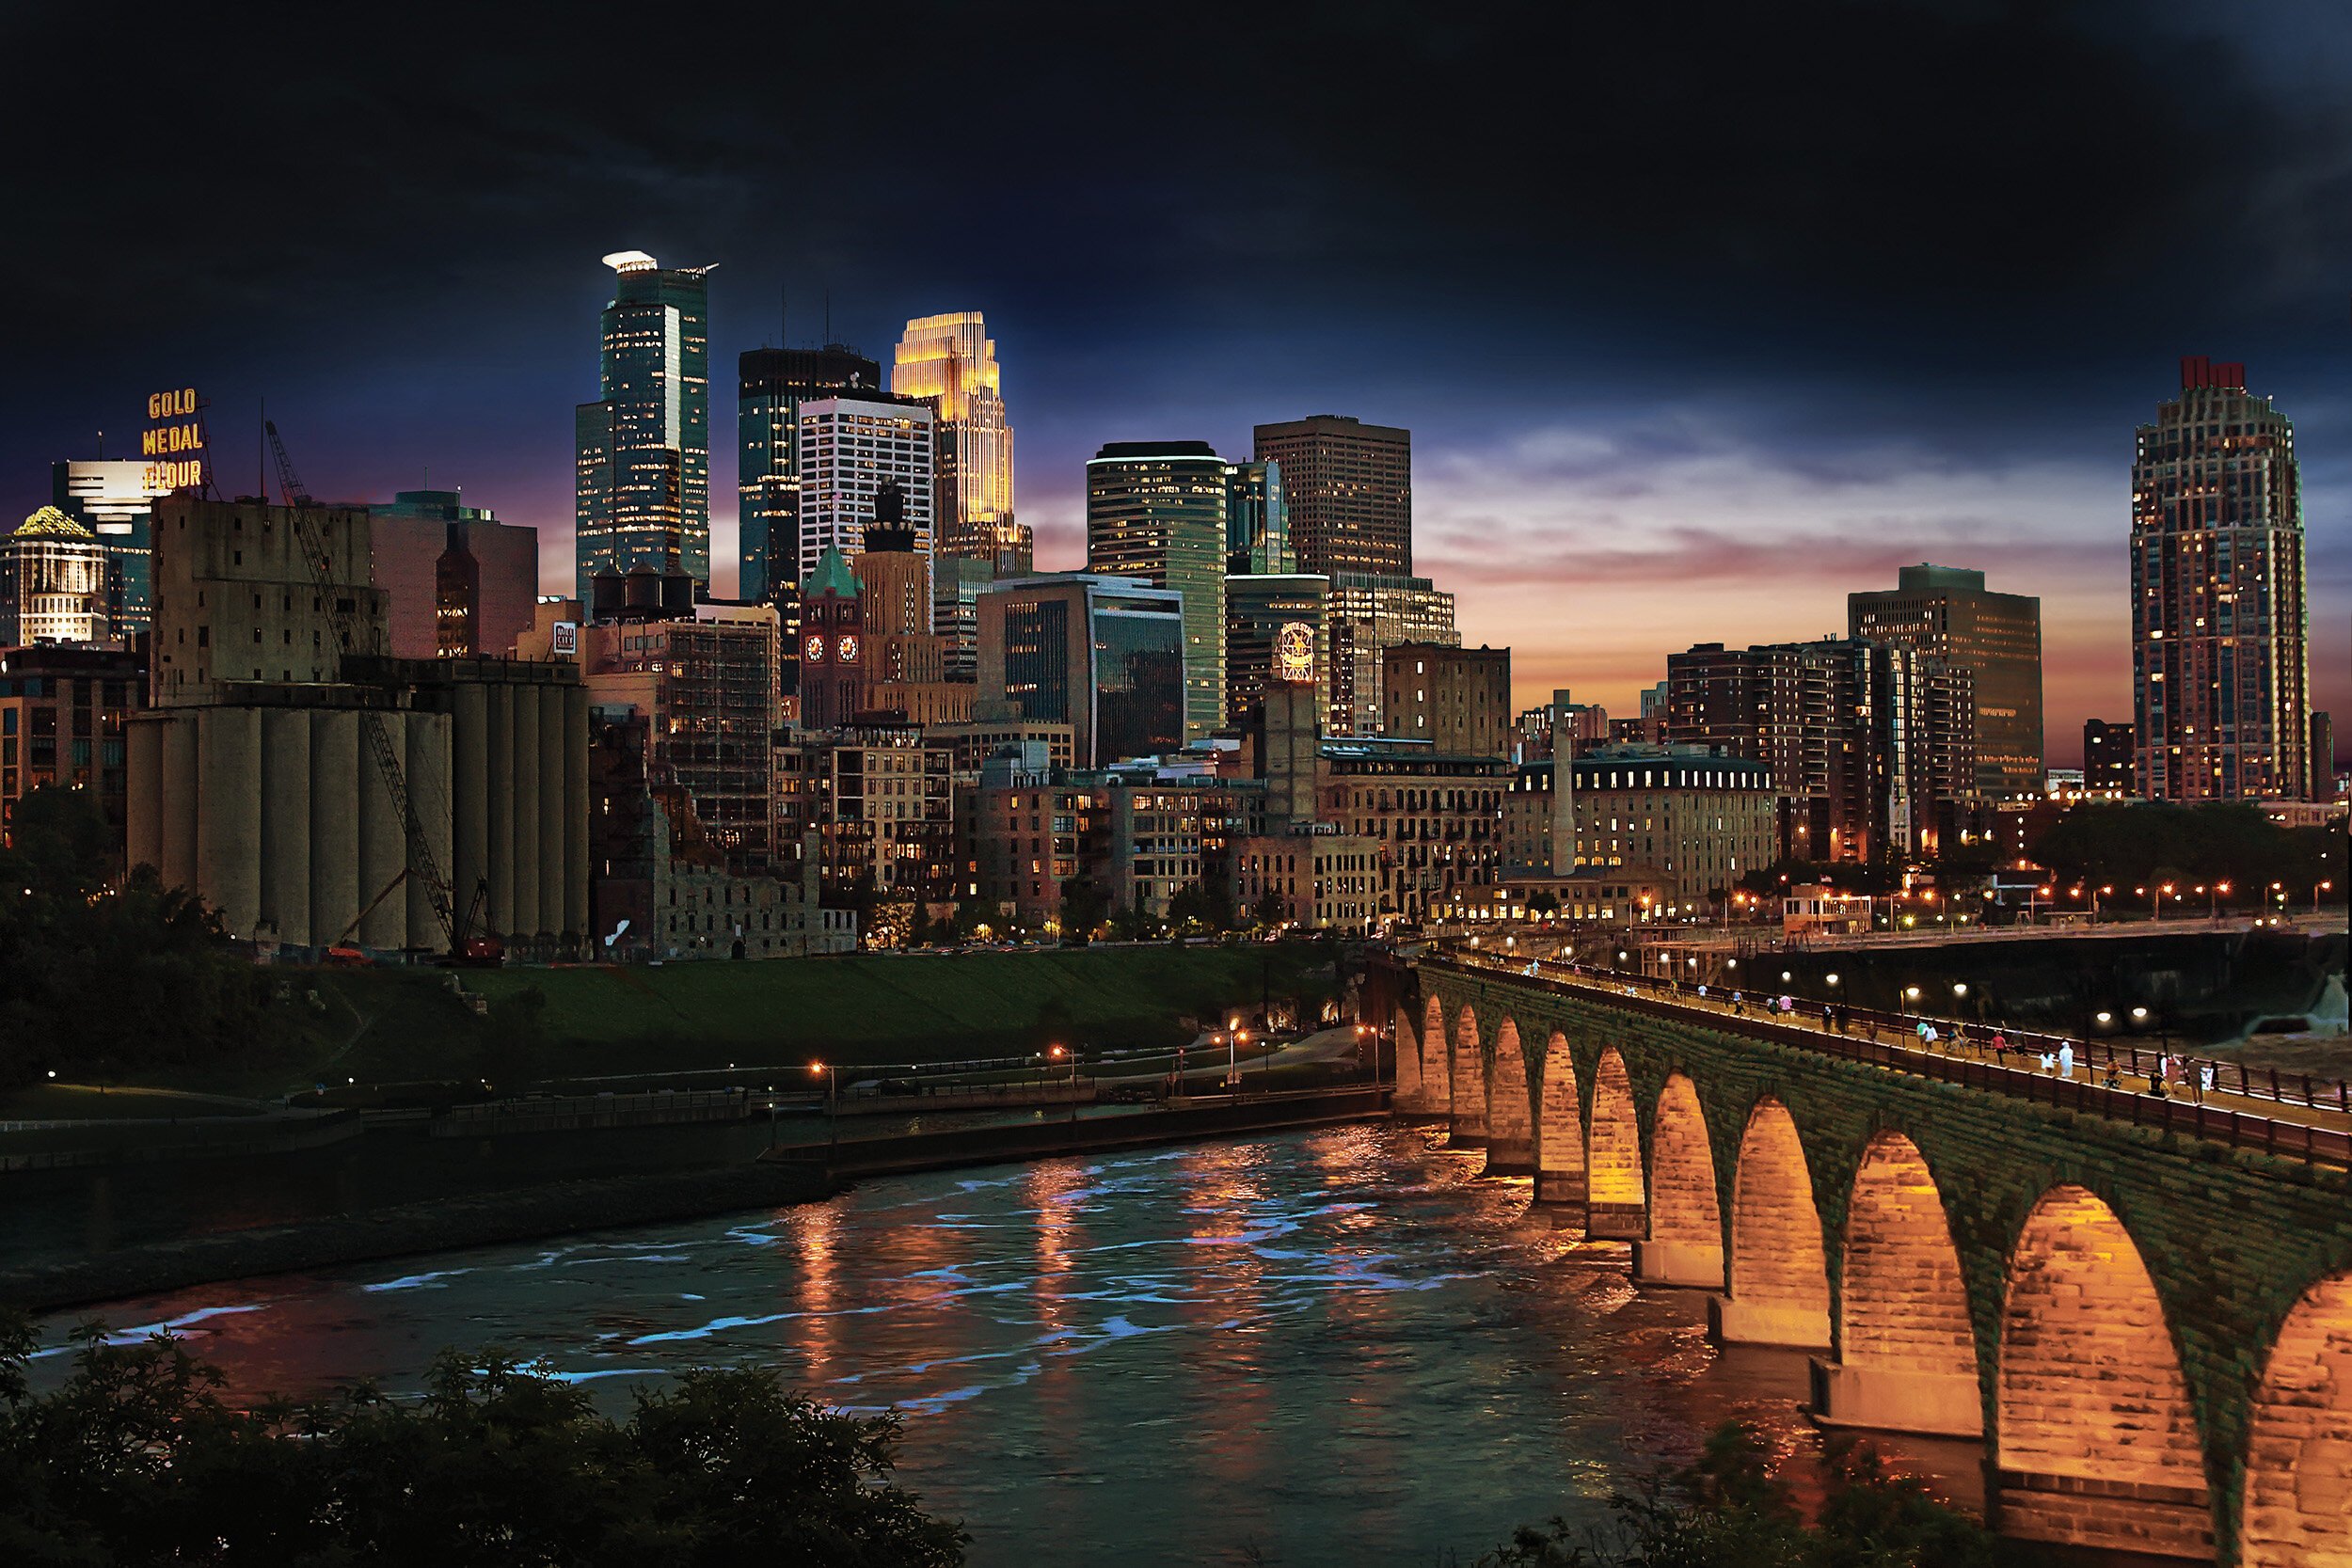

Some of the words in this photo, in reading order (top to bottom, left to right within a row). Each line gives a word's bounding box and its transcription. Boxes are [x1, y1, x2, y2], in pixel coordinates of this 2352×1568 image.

[149, 388, 196, 419] GOLD
[143, 423, 203, 455] MEDAL
[144, 460, 201, 491] FLOUR
[557, 636, 573, 644] CITY
